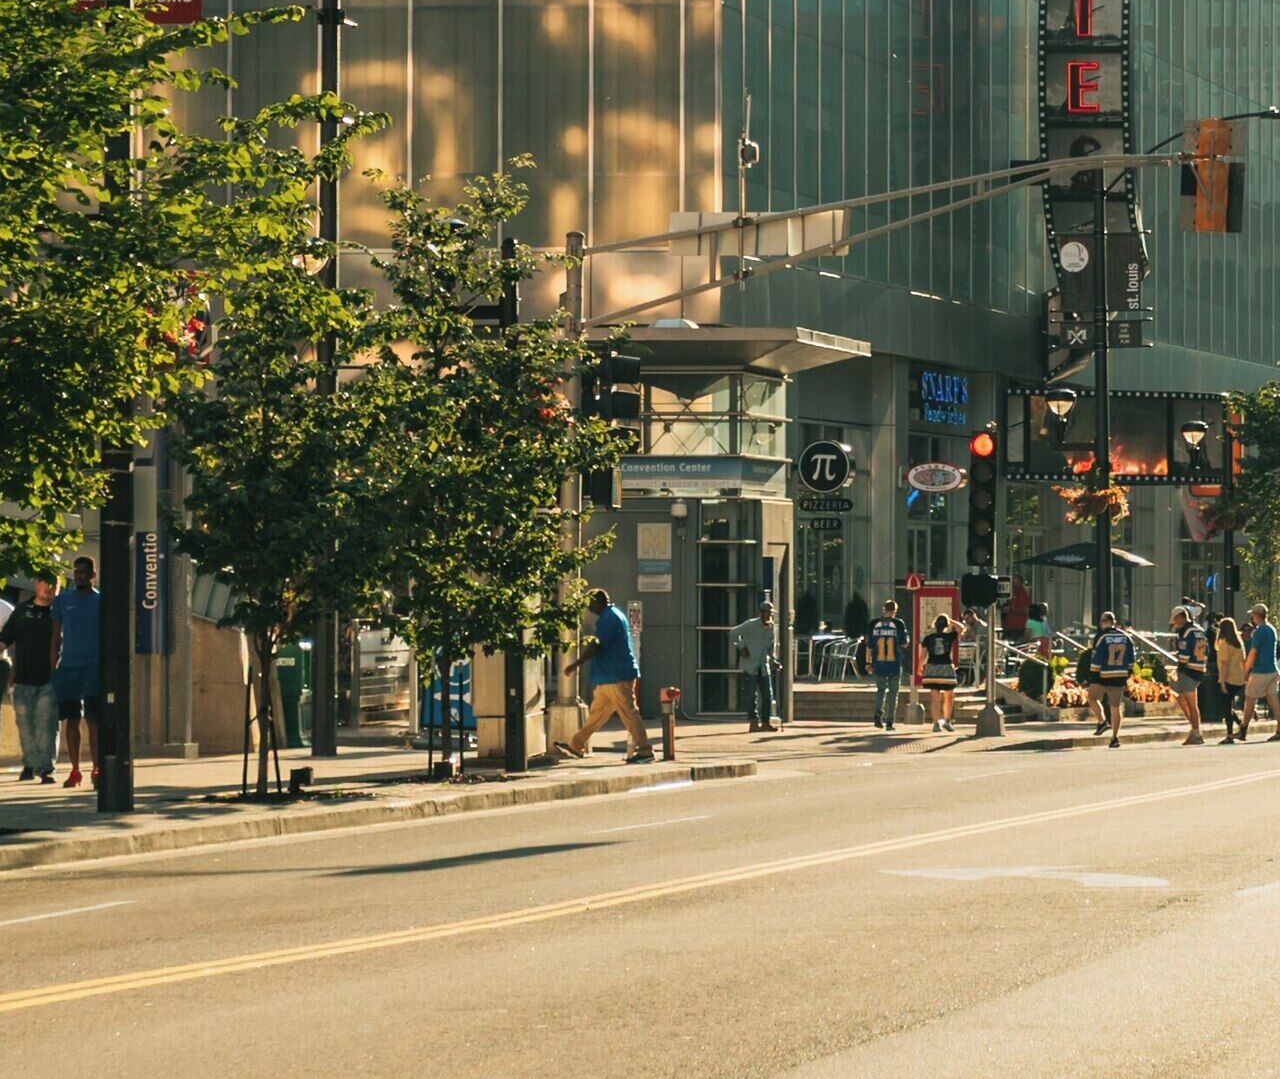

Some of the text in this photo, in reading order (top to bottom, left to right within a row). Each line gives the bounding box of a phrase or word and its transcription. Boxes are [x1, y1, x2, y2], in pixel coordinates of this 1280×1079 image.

[1125, 263, 1139, 309] st. louis
[621, 462, 712, 473] Convention Center
[803, 500, 850, 510] PIZZERIA
[813, 520, 839, 529] BEER
[877, 637, 895, 662] 11
[1108, 644, 1126, 666] 17
